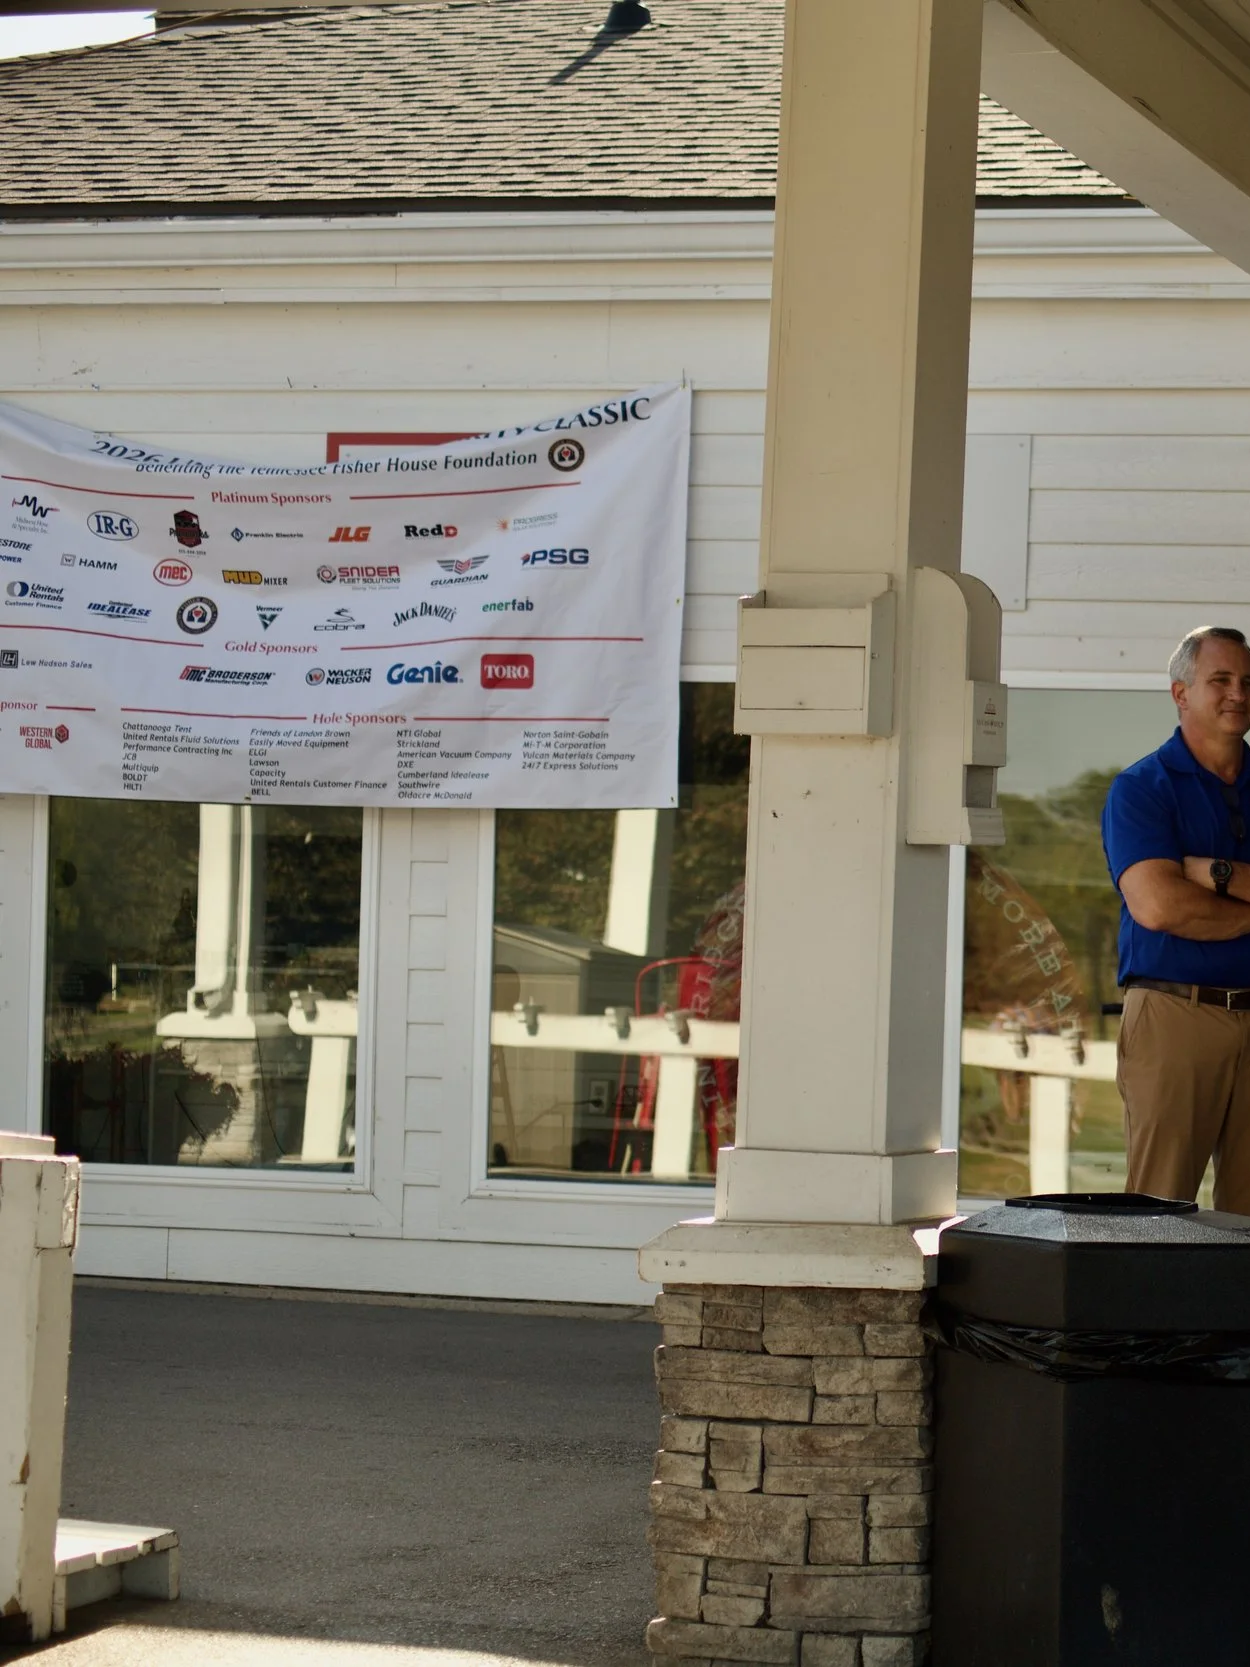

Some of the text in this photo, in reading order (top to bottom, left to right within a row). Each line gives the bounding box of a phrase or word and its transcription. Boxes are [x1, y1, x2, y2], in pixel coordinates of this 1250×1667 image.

[534, 397, 651, 432] CLASSIC
[387, 457, 438, 473] House
[444, 451, 537, 470] Foundation
[211, 491, 332, 507] Platinum Sponsors
[95, 514, 133, 538] IR-G
[328, 526, 371, 543] JLG
[530, 548, 589, 565] PSG
[79, 558, 117, 571] HAMM
[338, 566, 400, 577] SNIDER
[222, 570, 288, 586] MUD MIXER
[430, 574, 489, 586] GUARDIAN
[31, 583, 64, 595] United
[29, 591, 64, 603] Rentals
[36, 601, 62, 610] Finance
[87, 603, 152, 617] IDEALEASE
[482, 598, 534, 612] enerfab
[392, 607, 420, 628] JACK
[225, 640, 318, 655] Gold Sponsors
[70, 660, 93, 669] Sales
[208, 669, 273, 681] BRODERSON
[327, 667, 372, 677] WACKER
[387, 660, 459, 685] Genie
[484, 664, 529, 679] TORO
[205, 678, 250, 686] Manufacturing
[326, 675, 371, 685] NEUSON
[313, 712, 407, 726] Hole Sponsors
[19, 726, 53, 738] WESTERN
[122, 721, 192, 733] Chattanooga Tent
[250, 728, 351, 738] Friends of Landon Brown
[396, 729, 442, 738] NTI Global
[523, 730, 609, 740] Norton Saint-Gobain
[25, 738, 53, 749] GLOBAL
[123, 732, 240, 746] United Rentals Fluid Solutions
[248, 738, 349, 750] Easily Moved Equipment
[396, 740, 441, 749] Strickland
[123, 743, 233, 757] Performance Contracting Inc
[522, 741, 606, 751] Mi-T-M Corporation
[122, 752, 137, 761] JCB
[248, 748, 267, 757] ELGI
[396, 750, 512, 761] American Vacuum Company
[522, 751, 636, 762] Vulcan Materials Company
[122, 763, 159, 773] Multiquip
[249, 758, 280, 767] Lawson
[397, 760, 415, 769] DXE
[521, 762, 619, 772] 24/7 Express Solutions
[122, 773, 148, 782] BOLDT
[249, 768, 286, 779] Capacity
[397, 771, 490, 780] Cumberland Idealease
[123, 782, 142, 791] HILTI
[250, 779, 388, 789] United Rentals Customer Finance
[397, 781, 441, 789] Southwire
[251, 788, 271, 797] BELL
[397, 790, 473, 800] Oldacre McDonald
